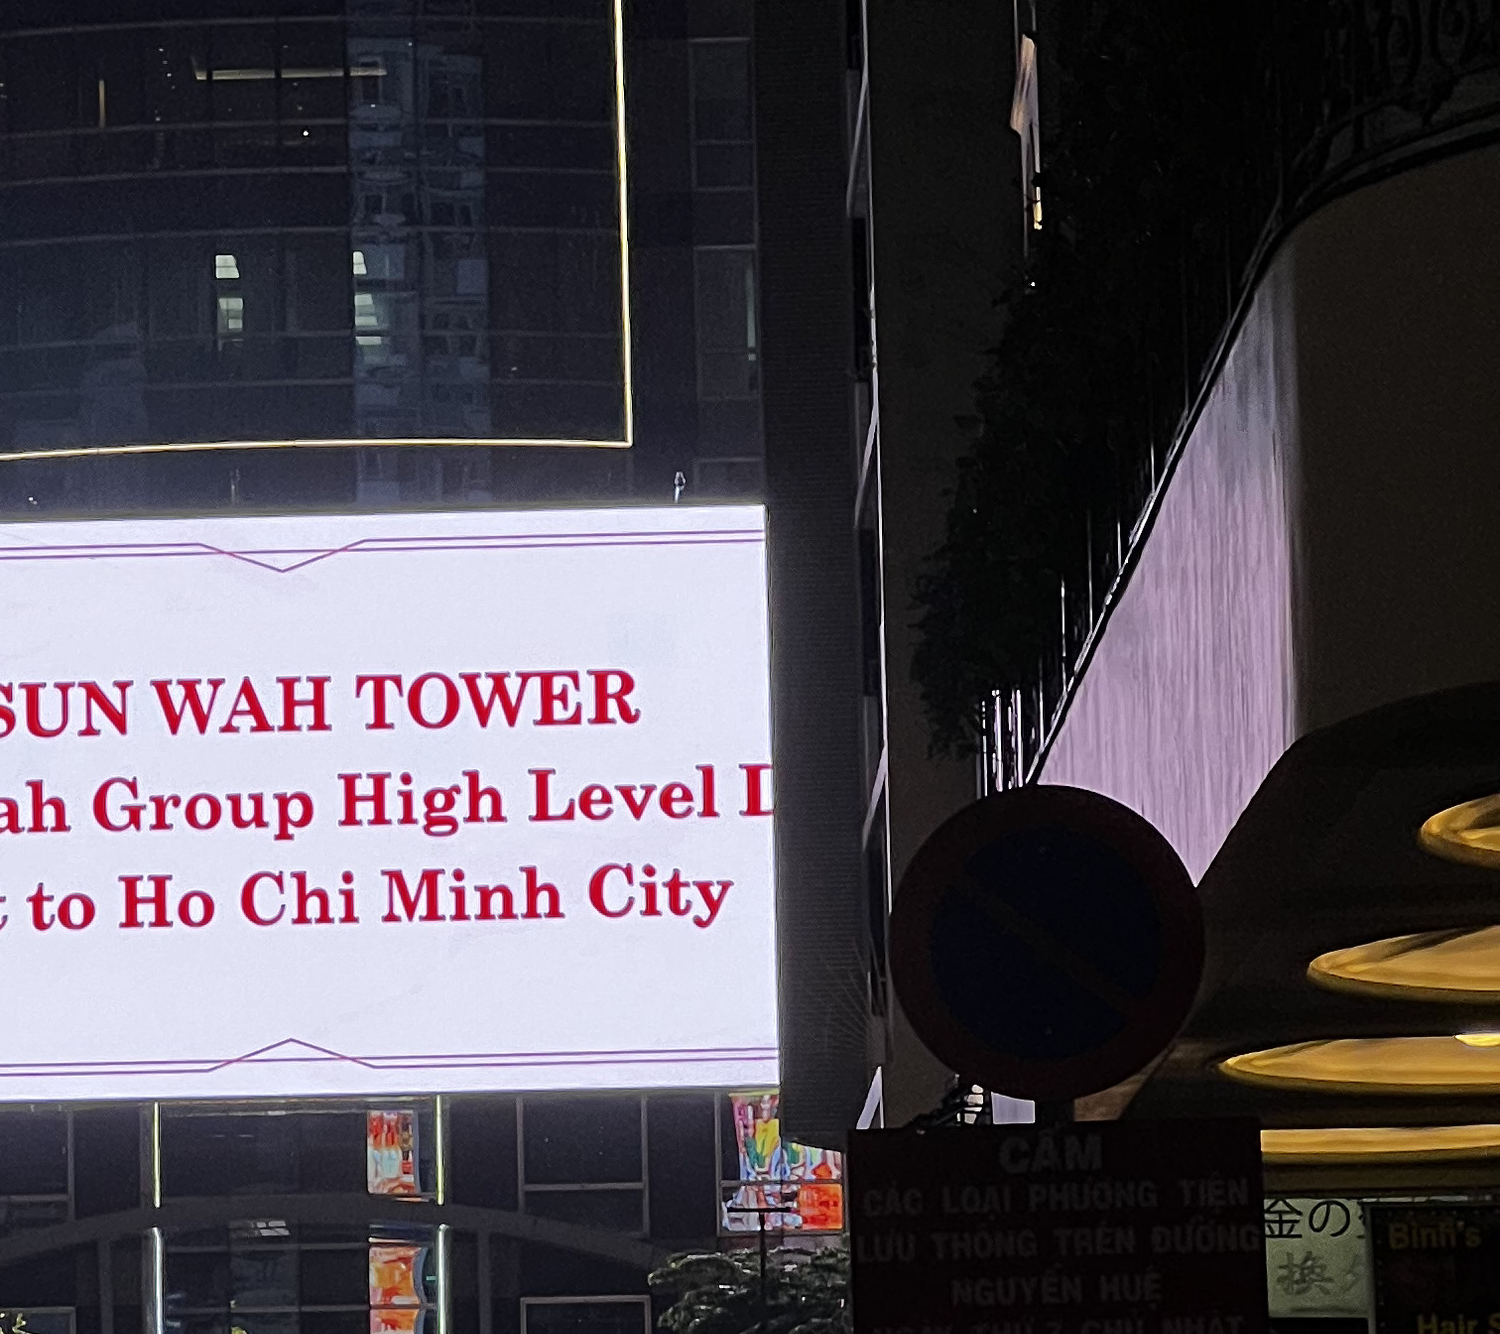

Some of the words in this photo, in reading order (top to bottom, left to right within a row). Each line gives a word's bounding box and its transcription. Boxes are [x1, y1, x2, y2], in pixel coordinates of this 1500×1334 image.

[151, 675, 330, 735] WAH
[355, 670, 641, 730] TOWER
[91, 779, 315, 842] Group
[339, 770, 506, 836] High
[530, 764, 721, 822] Level
[26, 885, 97, 932] to
[119, 875, 216, 929] Ho
[240, 870, 360, 927] Chi
[383, 869, 564, 923] Minh
[587, 863, 734, 929] City
[1264, 1198, 1364, 1239] 金の
